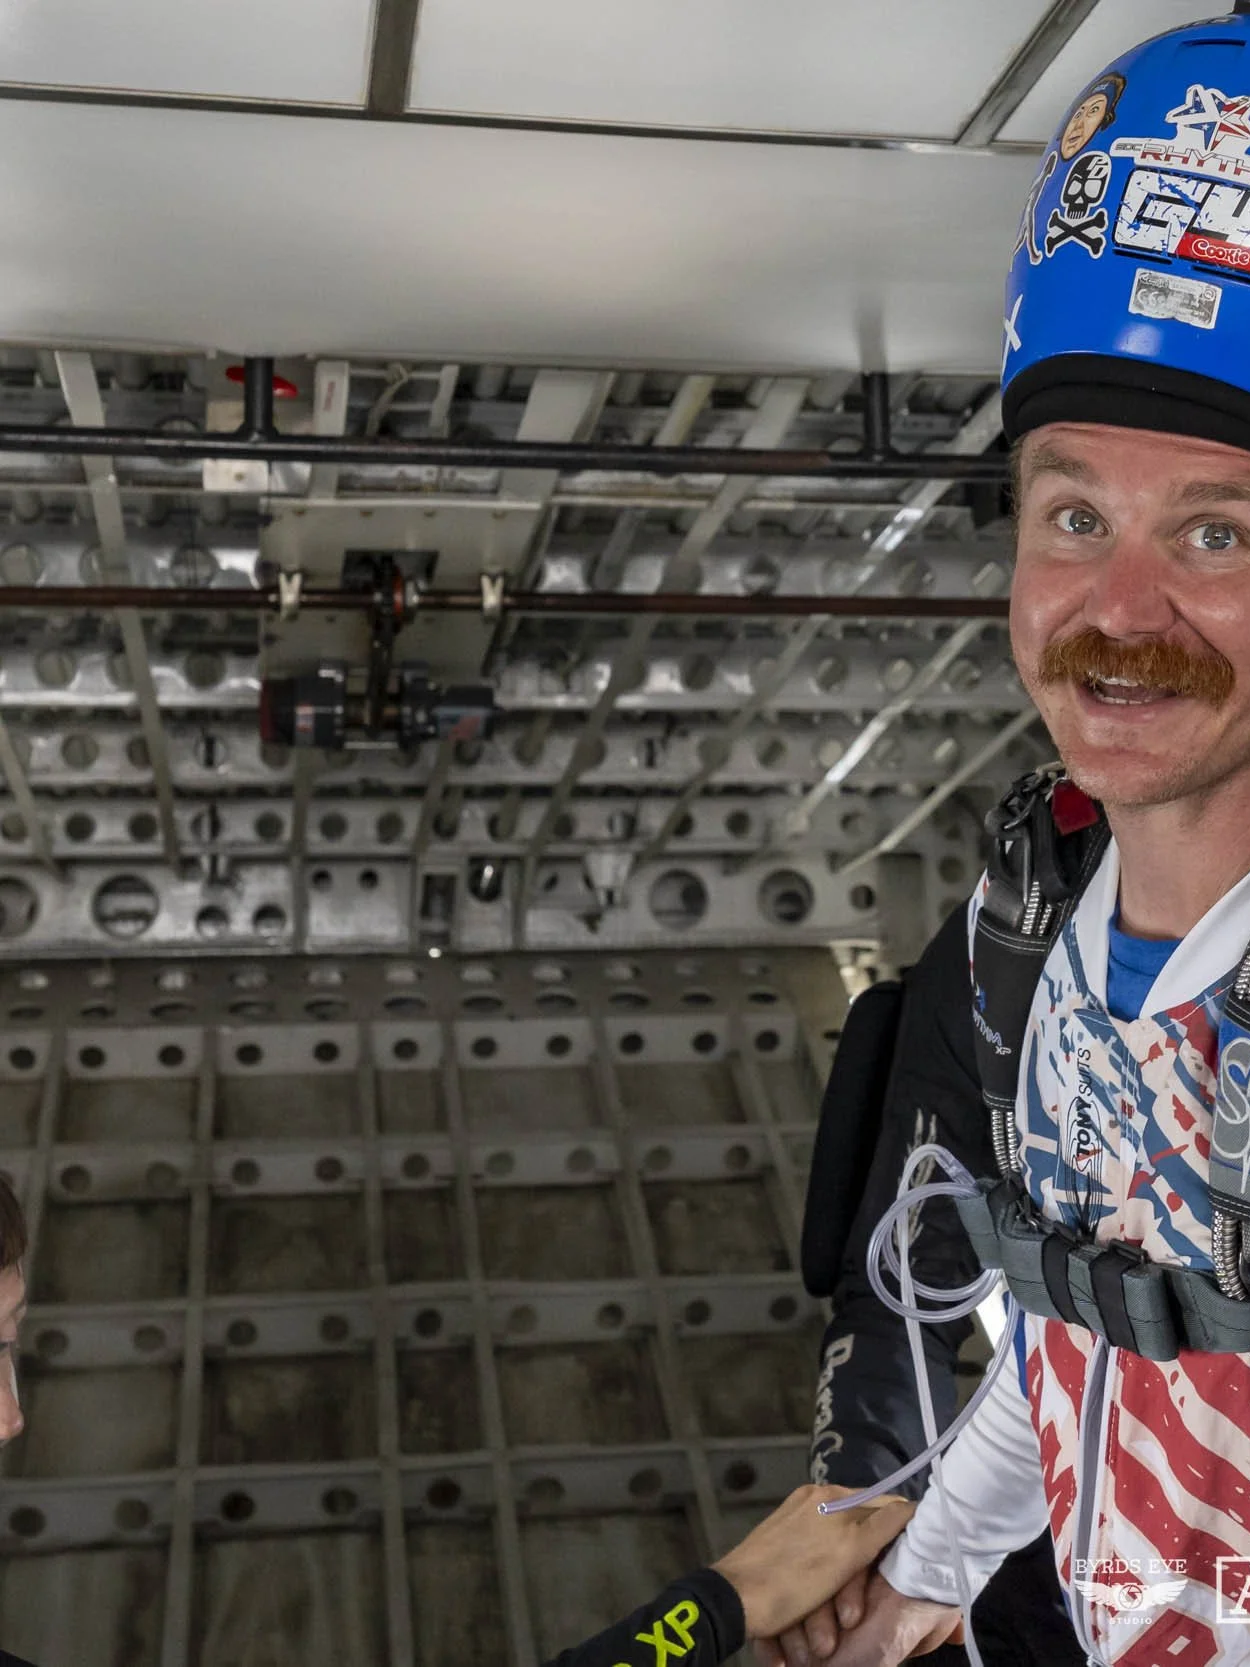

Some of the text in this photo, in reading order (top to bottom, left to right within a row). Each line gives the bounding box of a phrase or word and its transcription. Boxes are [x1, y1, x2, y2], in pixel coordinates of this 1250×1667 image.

[1191, 238, 1250, 265] Cookie
[1076, 1047, 1093, 1158] TONY SUITS
[635, 1599, 699, 1667] XP
